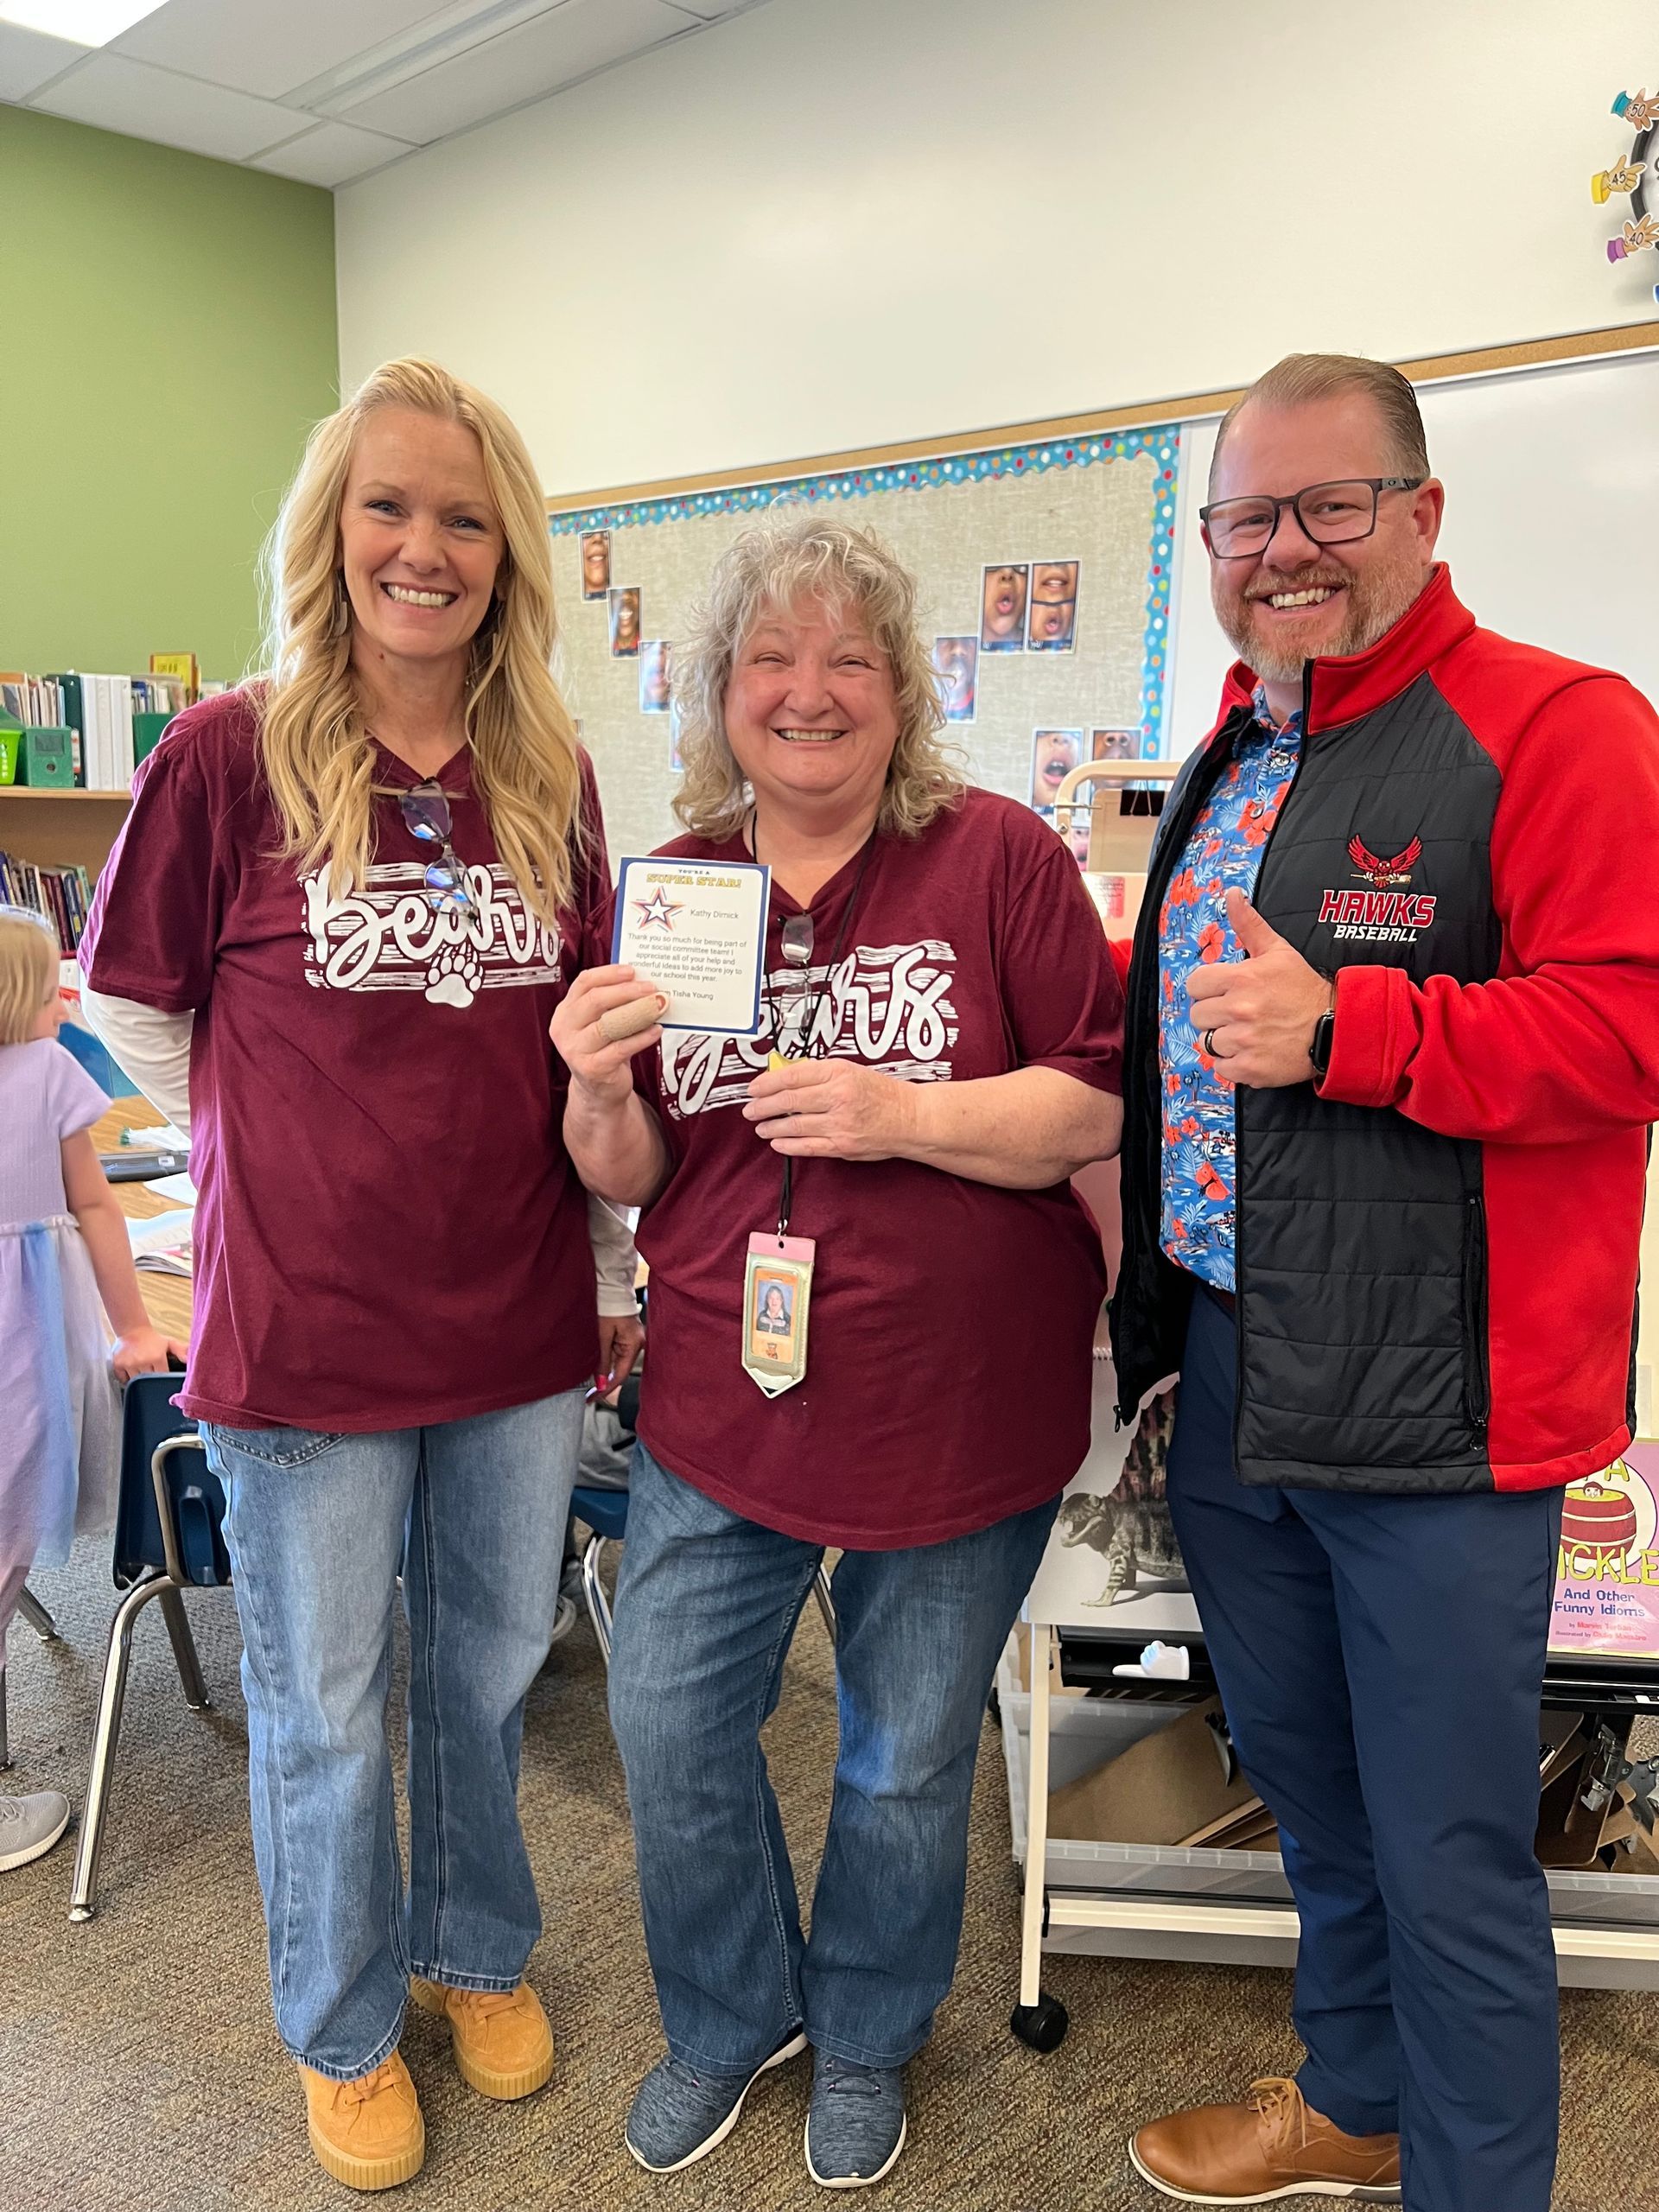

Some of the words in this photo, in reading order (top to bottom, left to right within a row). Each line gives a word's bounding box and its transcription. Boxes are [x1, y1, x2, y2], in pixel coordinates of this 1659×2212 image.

[1630, 103, 1646, 118] 50
[1611, 170, 1627, 186] 45
[1629, 232, 1644, 245] 40
[645, 873, 694, 885] SUPER
[696, 876, 742, 888] STAR!
[690, 909, 712, 919] Kathy
[1319, 889, 1438, 929] HAWKS
[1333, 925, 1418, 943] BASEBALL
[672, 945, 709, 954] committee
[703, 938, 723, 948] being
[724, 940, 738, 949] part
[636, 952, 671, 961] appreciate
[706, 956, 721, 965] help
[722, 957, 736, 966] and
[662, 963, 681, 971] ideas
[723, 966, 734, 976] joy
[664, 971, 686, 980] school
[702, 975, 718, 983] year.
[672, 989, 691, 998] Tisha
[692, 991, 714, 1001] Young
[1604, 1457, 1630, 1483] A
[1557, 1543, 1659, 1586] ICKLE
[1564, 1588, 1591, 1600] And
[1597, 1590, 1636, 1602] Other
[1554, 1600, 1595, 1616] Funny
[1600, 1604, 1645, 1618] Idioms
